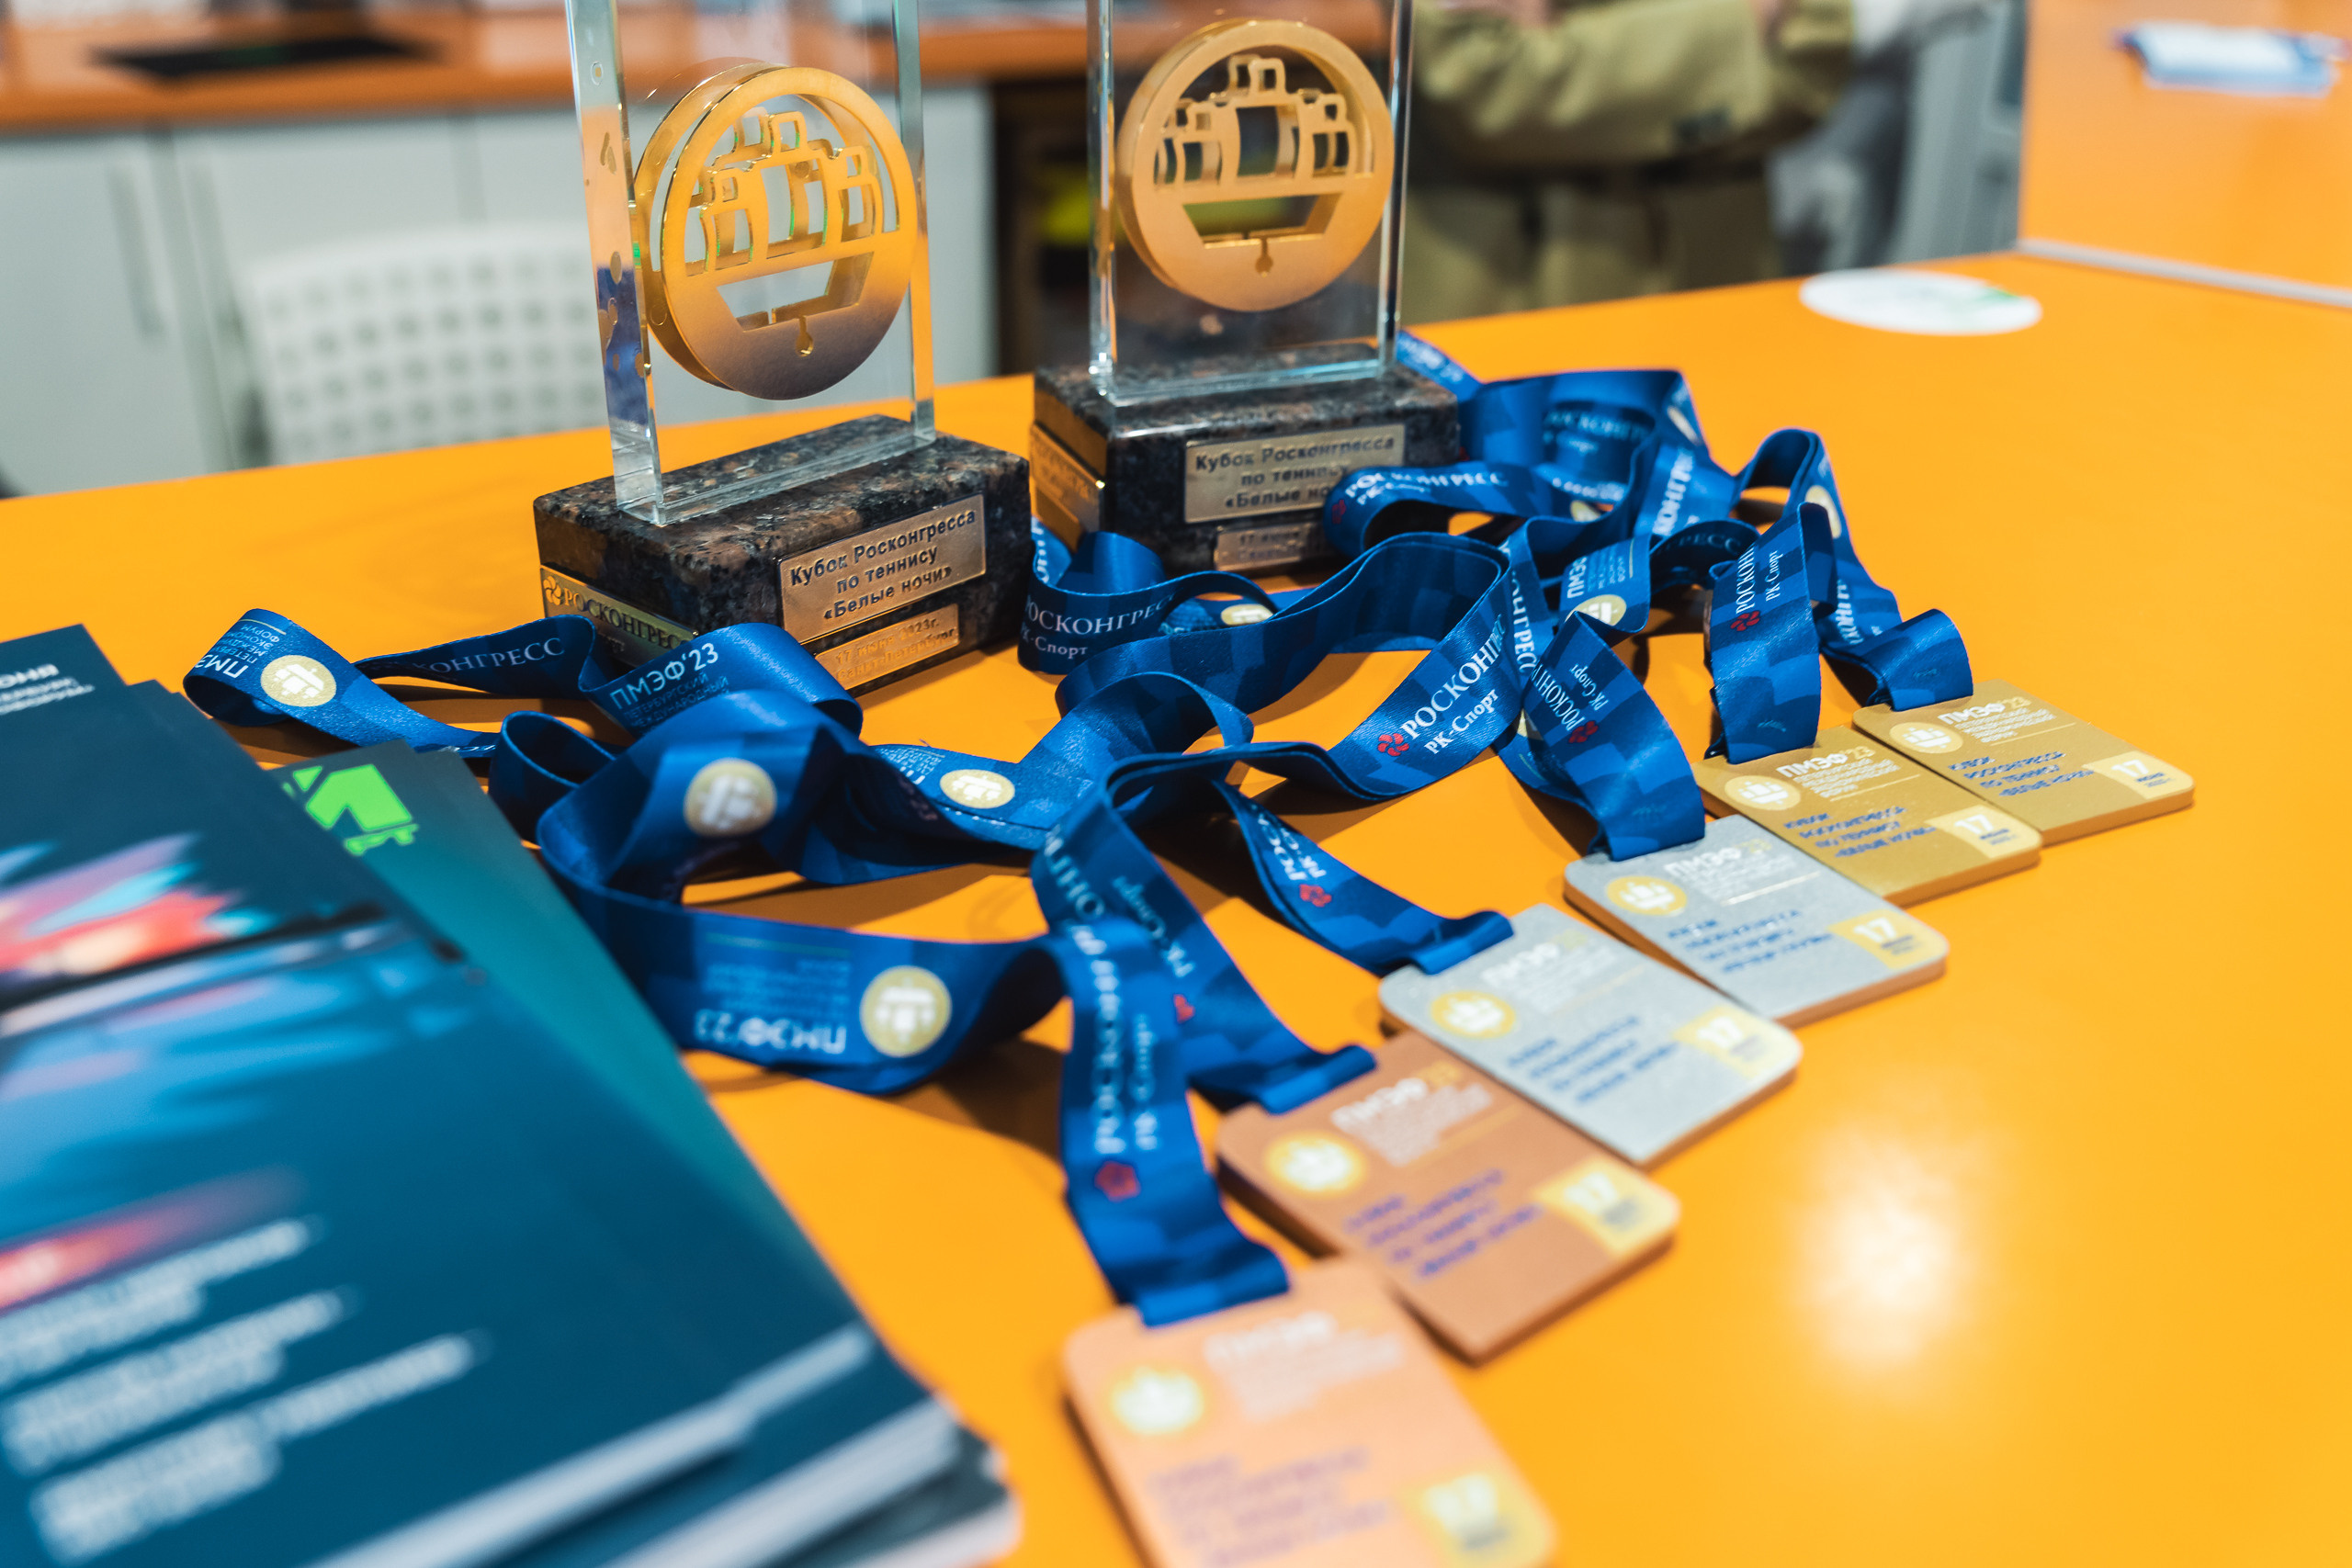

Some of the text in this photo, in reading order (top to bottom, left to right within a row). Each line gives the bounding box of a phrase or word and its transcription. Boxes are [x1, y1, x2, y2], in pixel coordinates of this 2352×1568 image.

[1196, 451, 1255, 473] Кубок
[790, 510, 976, 586] Кубок Росконгресса
[837, 547, 938, 594] по теннису
[823, 567, 953, 620] «Белые ночи»
[563, 587, 689, 649] РОСКОНГРЕС
[836, 649, 853, 664] 17
[1423, 689, 1499, 755] РК-Спорт
[2110, 759, 2150, 778] 17
[1953, 813, 1995, 834] 17
[1851, 916, 1897, 942] 17
